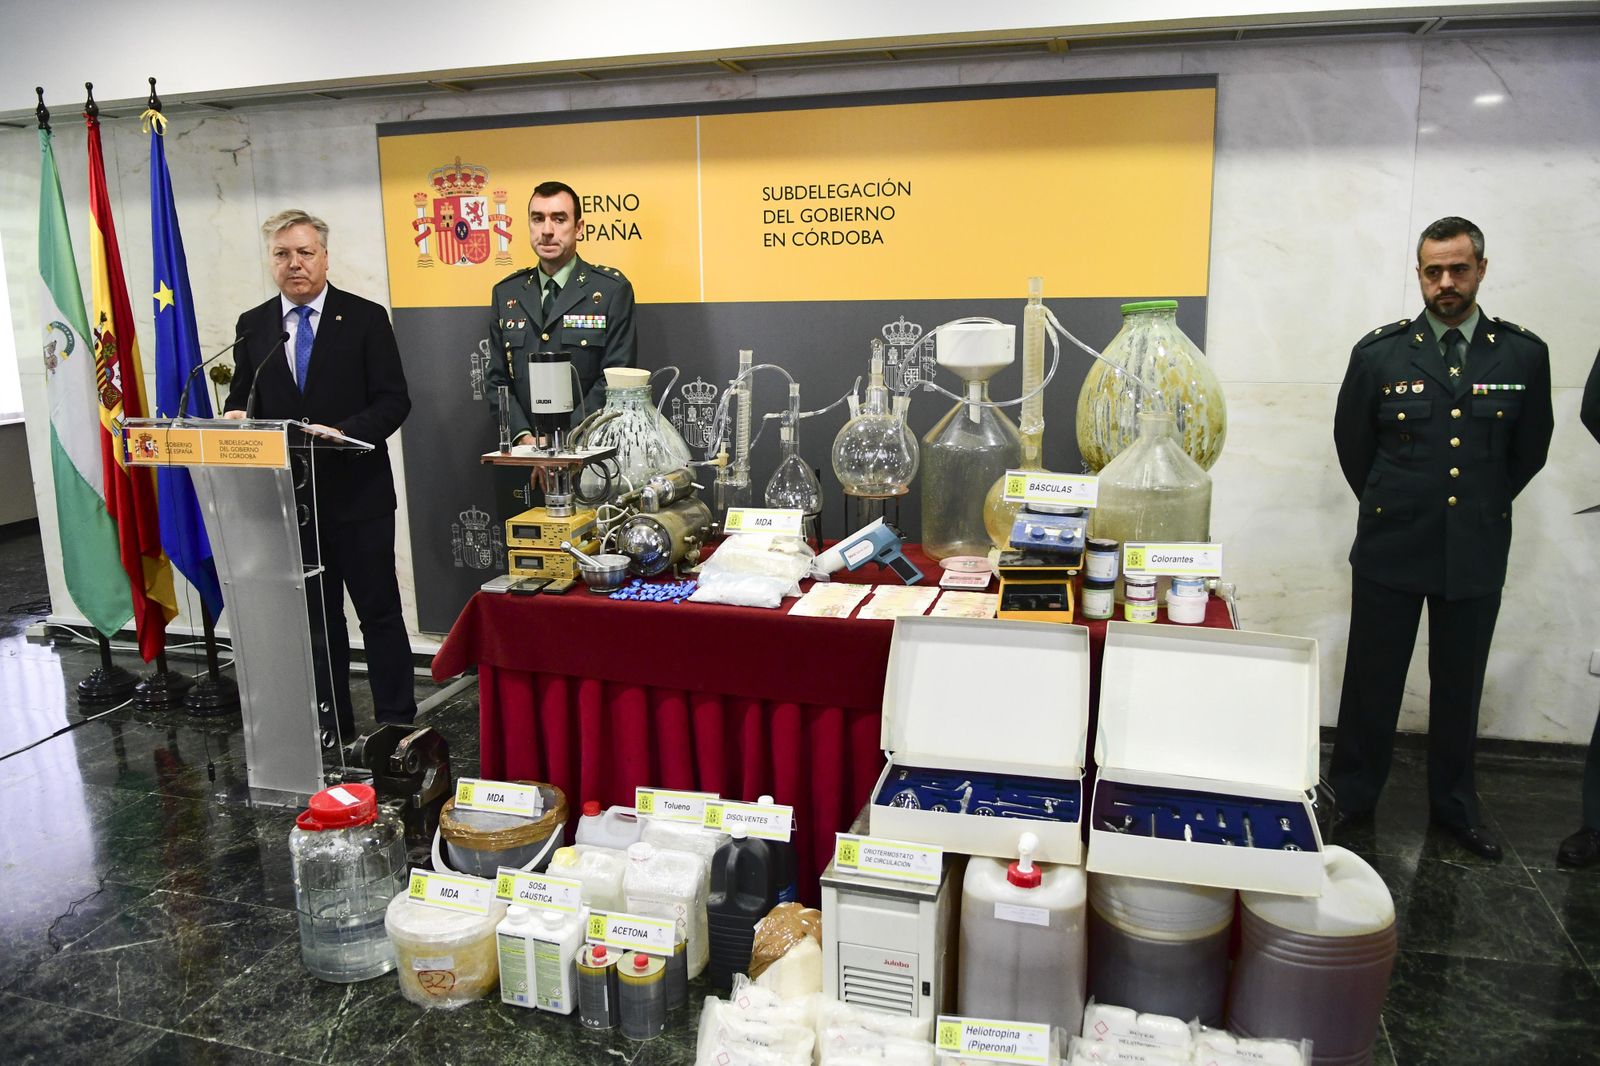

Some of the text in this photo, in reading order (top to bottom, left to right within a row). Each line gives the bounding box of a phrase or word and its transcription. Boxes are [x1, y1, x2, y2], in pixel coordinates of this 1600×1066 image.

[762, 177, 912, 201] SUBDELEGACIÓN
[578, 192, 640, 214] ERNO
[763, 205, 895, 224] DEL GOBIERNO
[763, 227, 884, 247] EN CÓRDOBA
[754, 518, 773, 527] MDA
[1151, 554, 1194, 564] Colorantes
[486, 793, 505, 803] MDA
[663, 801, 691, 812] Tolueno
[726, 812, 769, 824] DISOLVENTES
[863, 847, 914, 860] CRIOTERMOSTATO
[439, 887, 460, 899] MDA
[528, 881, 547, 892] SOSA
[612, 925, 649, 939] ACETONA
[965, 1025, 1021, 1040] Heliotropina
[967, 1040, 1017, 1055] (Piperonal)
